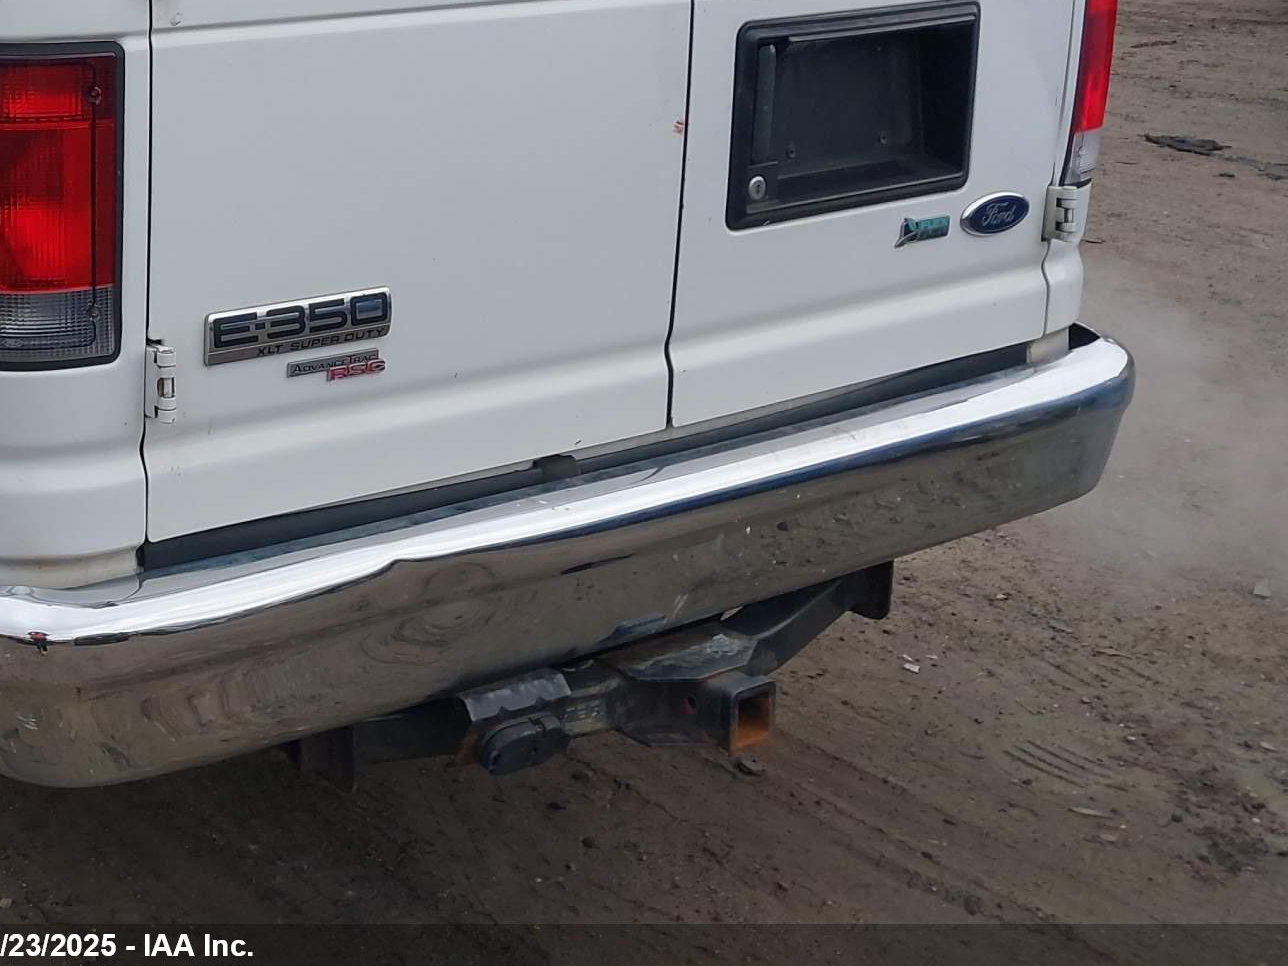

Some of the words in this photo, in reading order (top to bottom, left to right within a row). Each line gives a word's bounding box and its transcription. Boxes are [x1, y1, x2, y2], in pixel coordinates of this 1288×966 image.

[982, 201, 1017, 227] Ford
[212, 291, 388, 349] E-350
[256, 344, 283, 357] XLT
[290, 335, 340, 352] SUPER
[343, 328, 387, 343] DUTY
[328, 358, 386, 382] RSC
